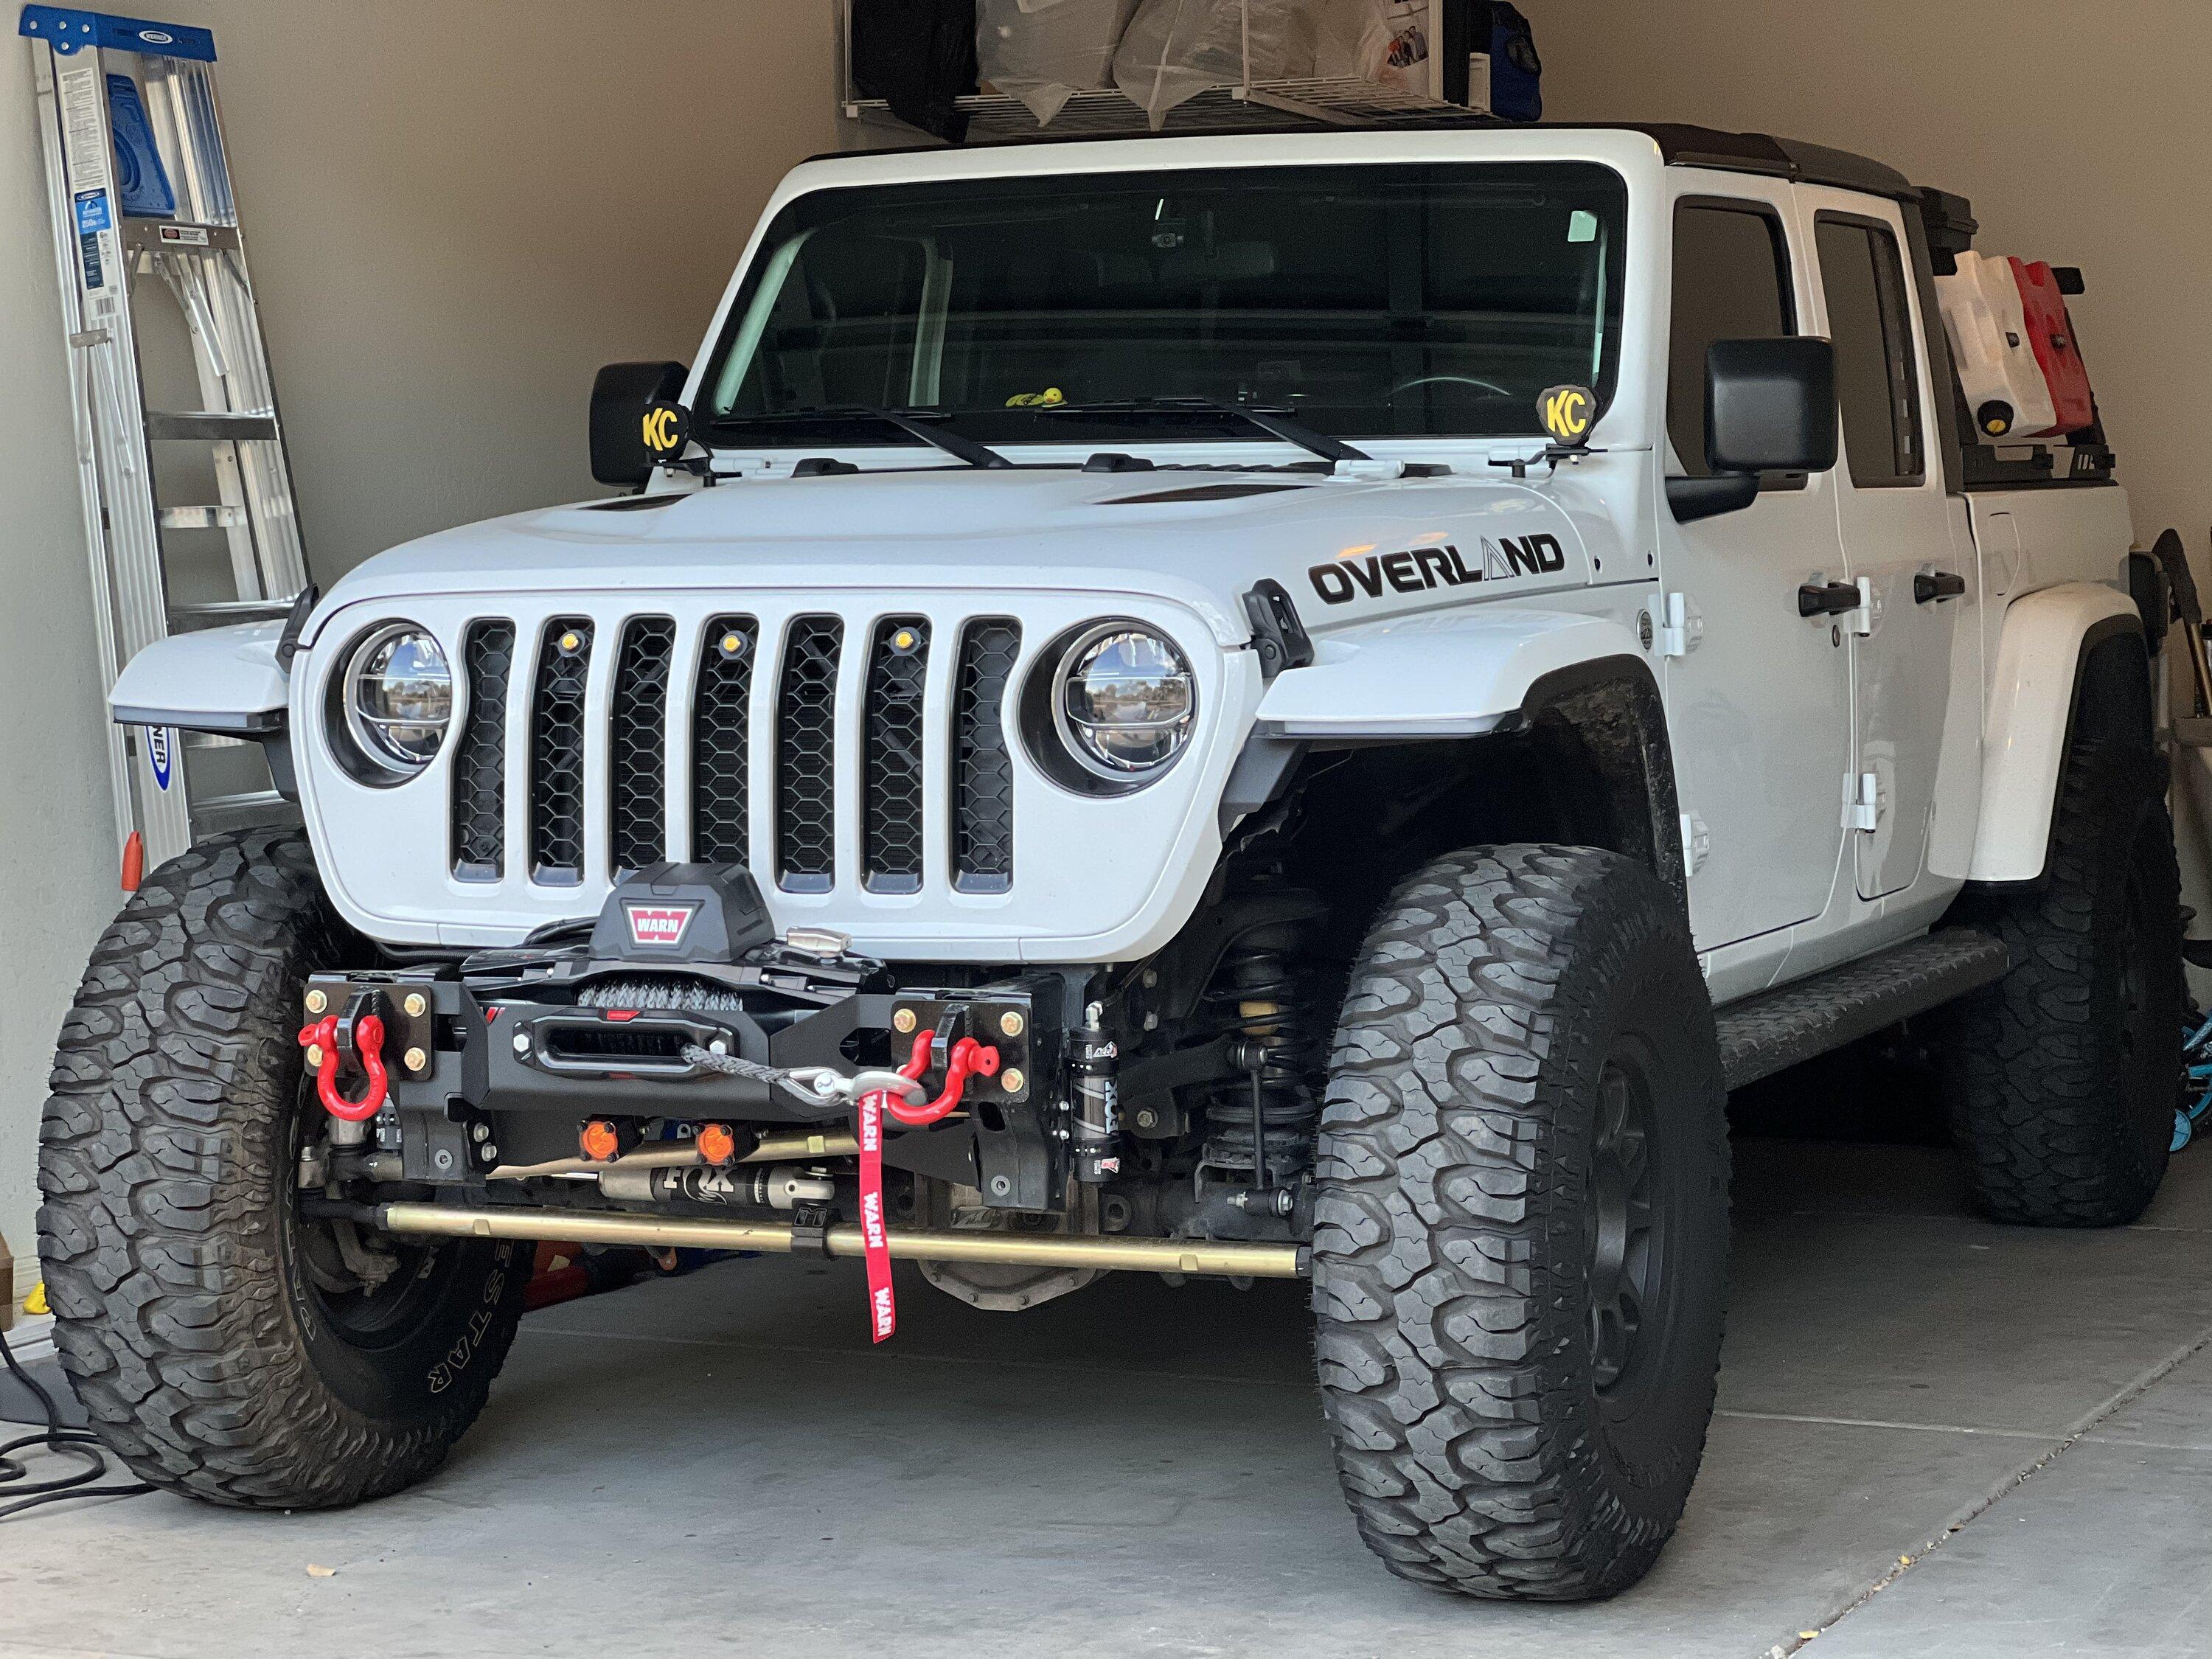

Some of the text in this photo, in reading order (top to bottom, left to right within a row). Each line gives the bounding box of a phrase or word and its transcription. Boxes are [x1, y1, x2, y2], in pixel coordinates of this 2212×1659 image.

[642, 408, 678, 451] KC
[1546, 390, 1586, 437] KC
[1308, 533, 1565, 605] OVERLAND
[153, 726, 166, 764] NER
[637, 918, 679, 933] WARN
[863, 1093, 878, 1152] WARN
[663, 1166, 734, 1196] FOX
[863, 1192, 884, 1248] WARN
[428, 1239, 515, 1393] ESTAR
[874, 1287, 892, 1336] WARN
